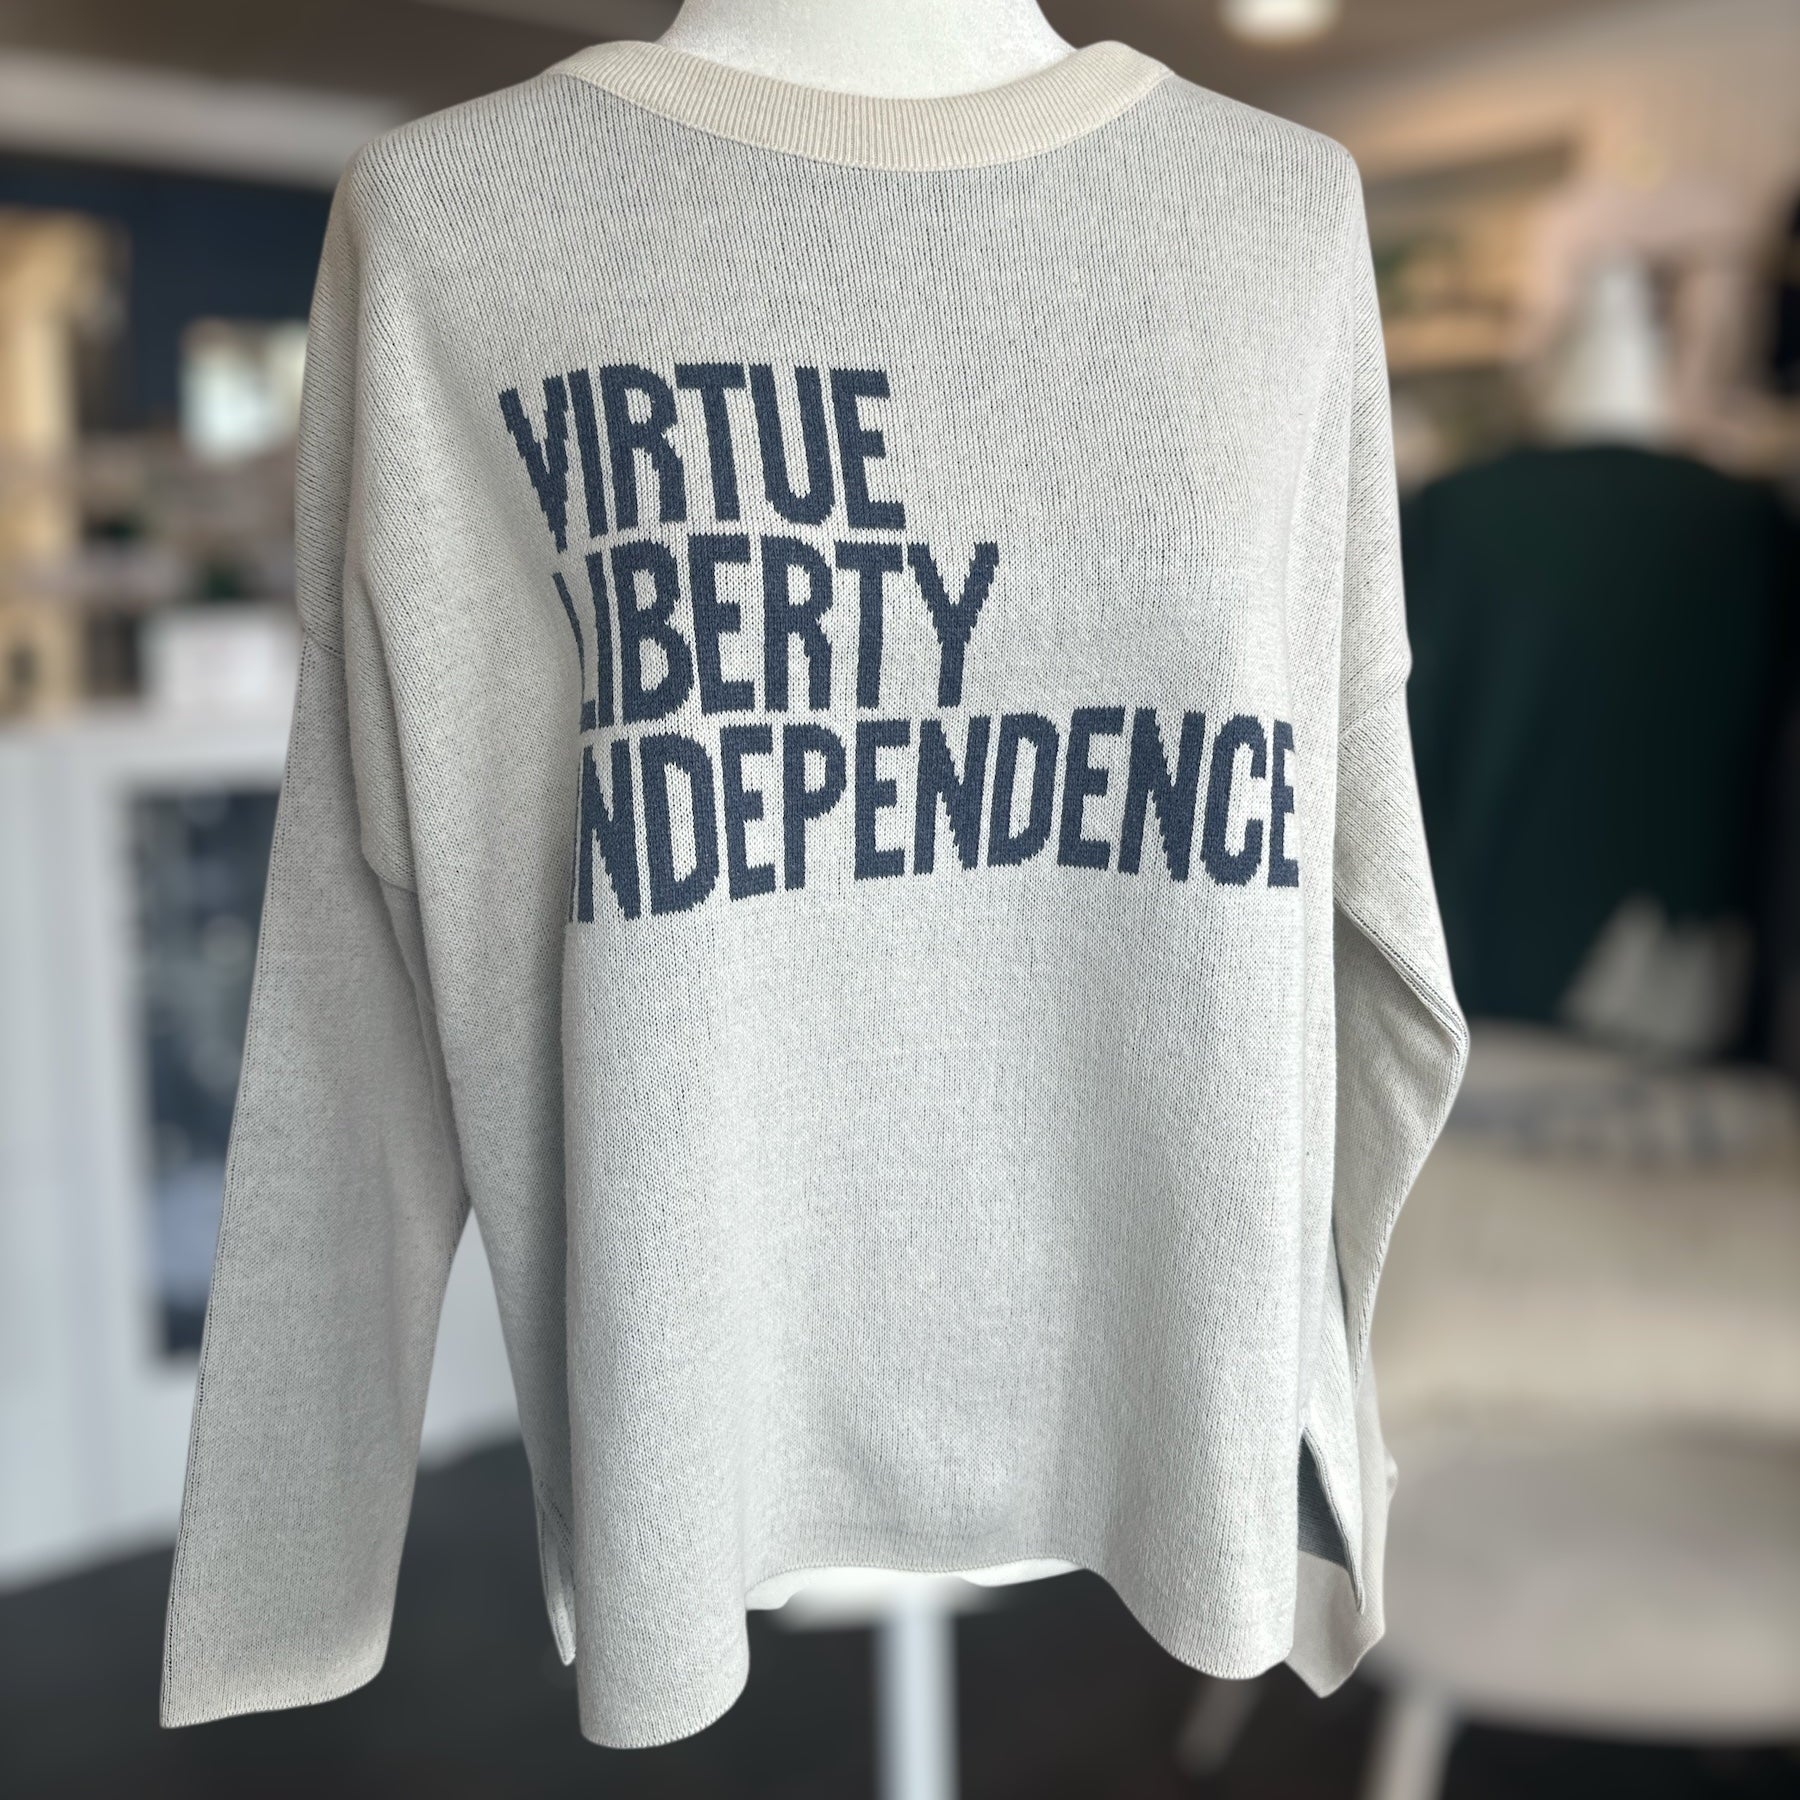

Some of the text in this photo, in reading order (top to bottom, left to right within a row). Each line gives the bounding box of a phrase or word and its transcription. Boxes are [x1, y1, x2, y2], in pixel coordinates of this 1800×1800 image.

[498, 359, 906, 554] VIRTUE
[551, 532, 1000, 735] LIBERTY
[569, 704, 1299, 925] NDEPENDENCE
